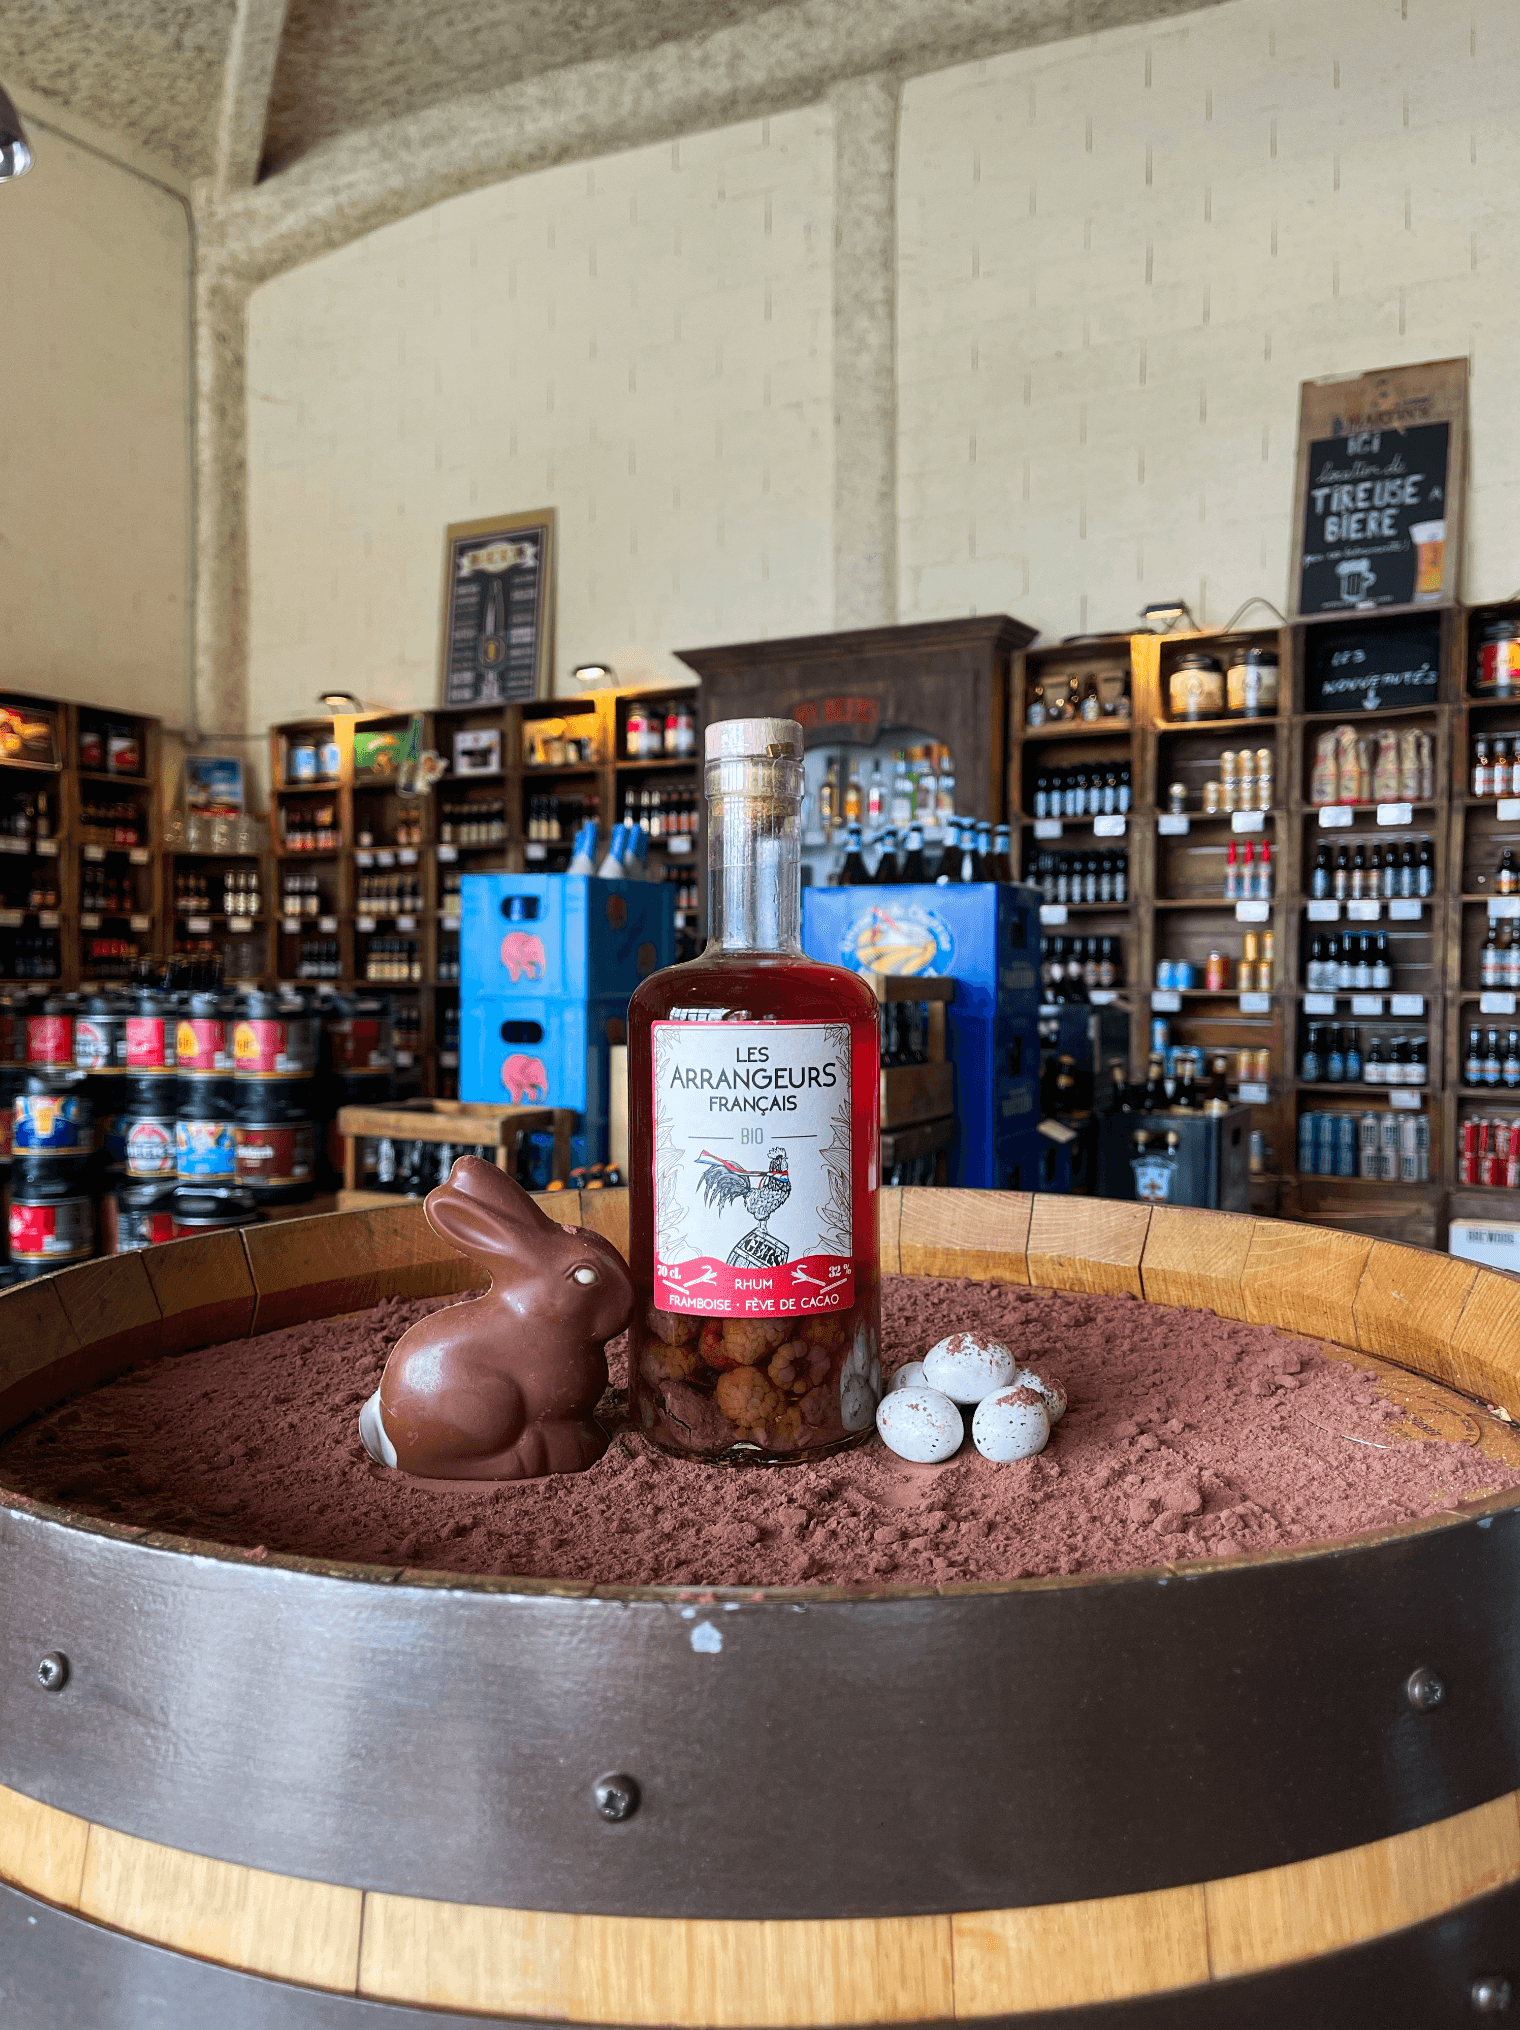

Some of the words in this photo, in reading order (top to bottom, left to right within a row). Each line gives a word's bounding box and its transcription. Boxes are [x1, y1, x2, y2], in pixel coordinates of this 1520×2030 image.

[1311, 473, 1425, 515] TIREUSE
[736, 1046, 770, 1063] LES
[670, 1062, 837, 1091] ARRANGEURS
[709, 1094, 798, 1116] FRANÇAIS
[741, 1127, 764, 1145] BIO
[656, 1264, 668, 1278] 70
[828, 1265, 842, 1278] 32
[843, 1263, 852, 1275] %
[734, 1278, 773, 1291] RHUM
[669, 1294, 732, 1311] FRAMBOISE
[745, 1297, 776, 1311] FÈVE
[780, 1298, 797, 1310] DE
[800, 1293, 840, 1309] CACAO
